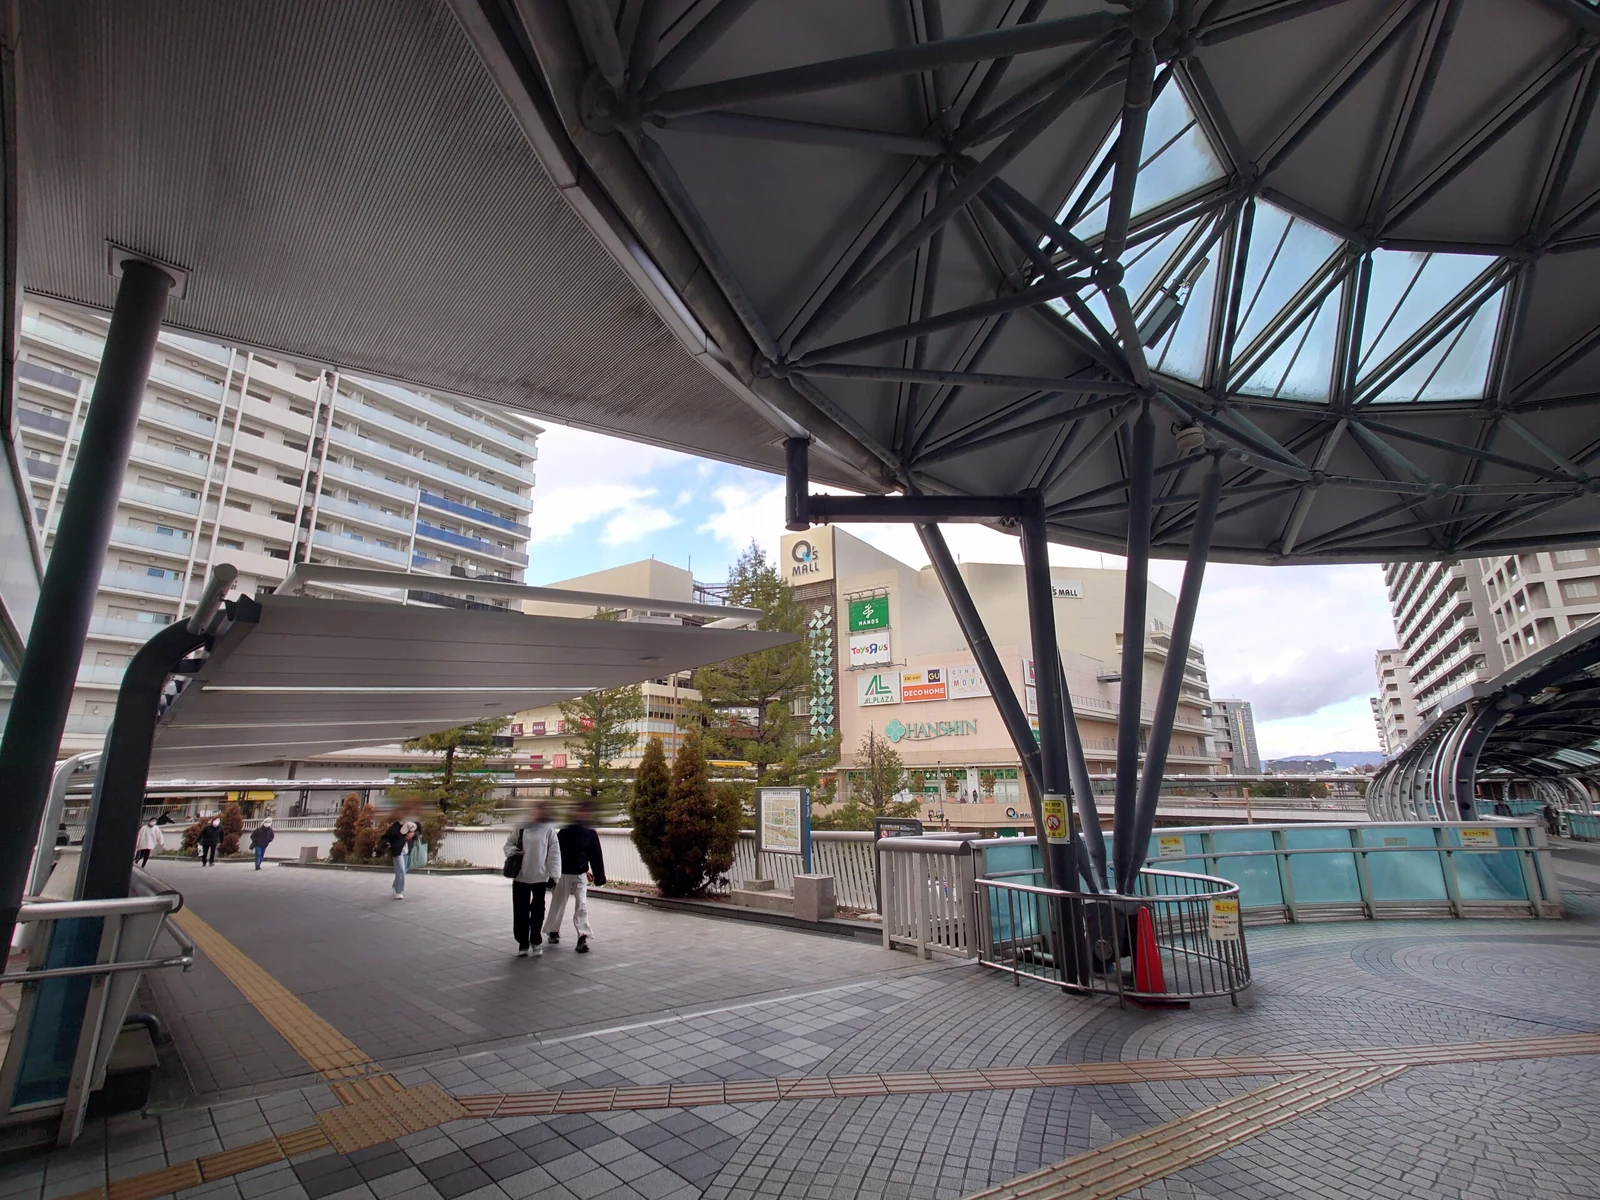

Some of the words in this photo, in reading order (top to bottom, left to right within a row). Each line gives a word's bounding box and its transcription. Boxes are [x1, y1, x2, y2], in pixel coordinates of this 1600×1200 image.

[792, 562, 819, 576] MALL
[1059, 589, 1078, 597] MALL
[858, 618, 879, 626] HANDS
[928, 672, 940, 680] GU
[953, 677, 983, 687] MOVI
[904, 689, 923, 697] DECO
[924, 687, 945, 695] HOME
[906, 719, 977, 738] HANSHIN
